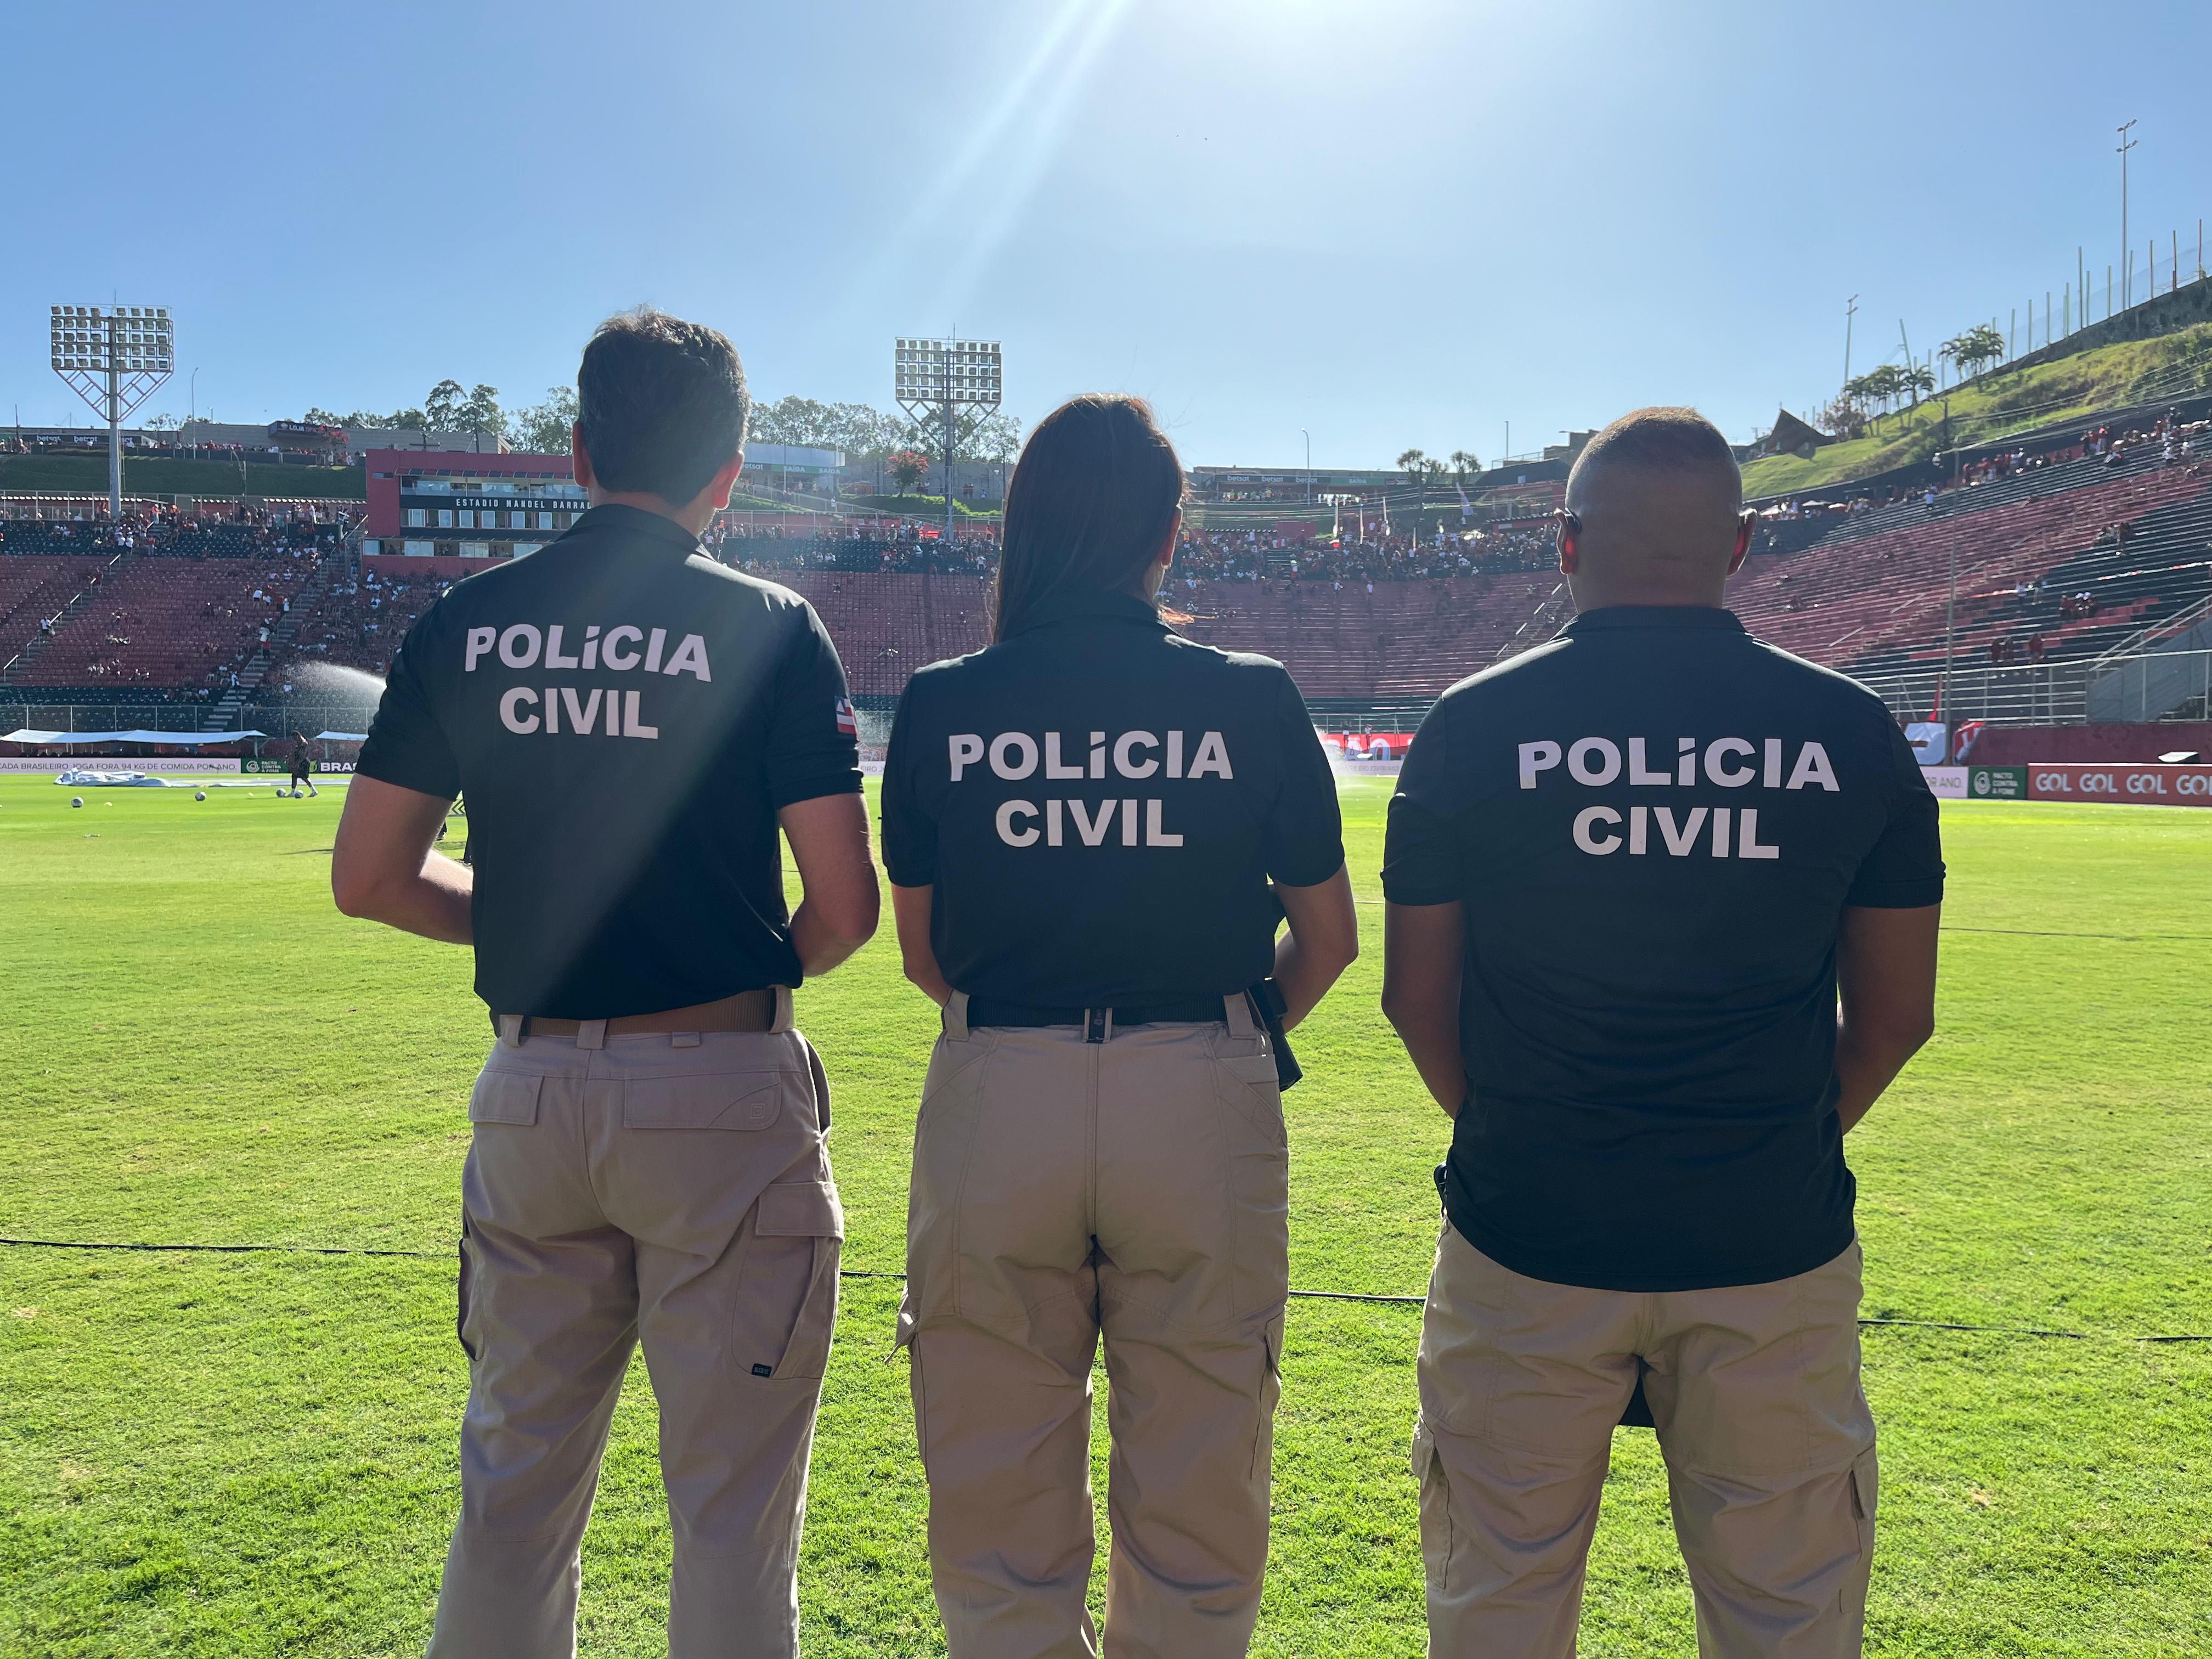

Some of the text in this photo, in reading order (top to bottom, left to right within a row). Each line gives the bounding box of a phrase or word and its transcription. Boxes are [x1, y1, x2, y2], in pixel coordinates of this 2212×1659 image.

[456, 498, 499, 507] ESTADIO
[506, 500, 545, 509] MANOEL
[465, 624, 712, 682] POLÍCIA
[500, 687, 658, 739] CIVIL
[949, 730, 1233, 782] POLÍCIA
[1518, 737, 1840, 792] POLÍCIA
[2036, 772, 2072, 792] GOL
[2079, 773, 2118, 793] GOL
[2126, 774, 2167, 794] GOL
[996, 799, 1183, 847] CIVIL
[1572, 806, 1779, 859] CIVIL
